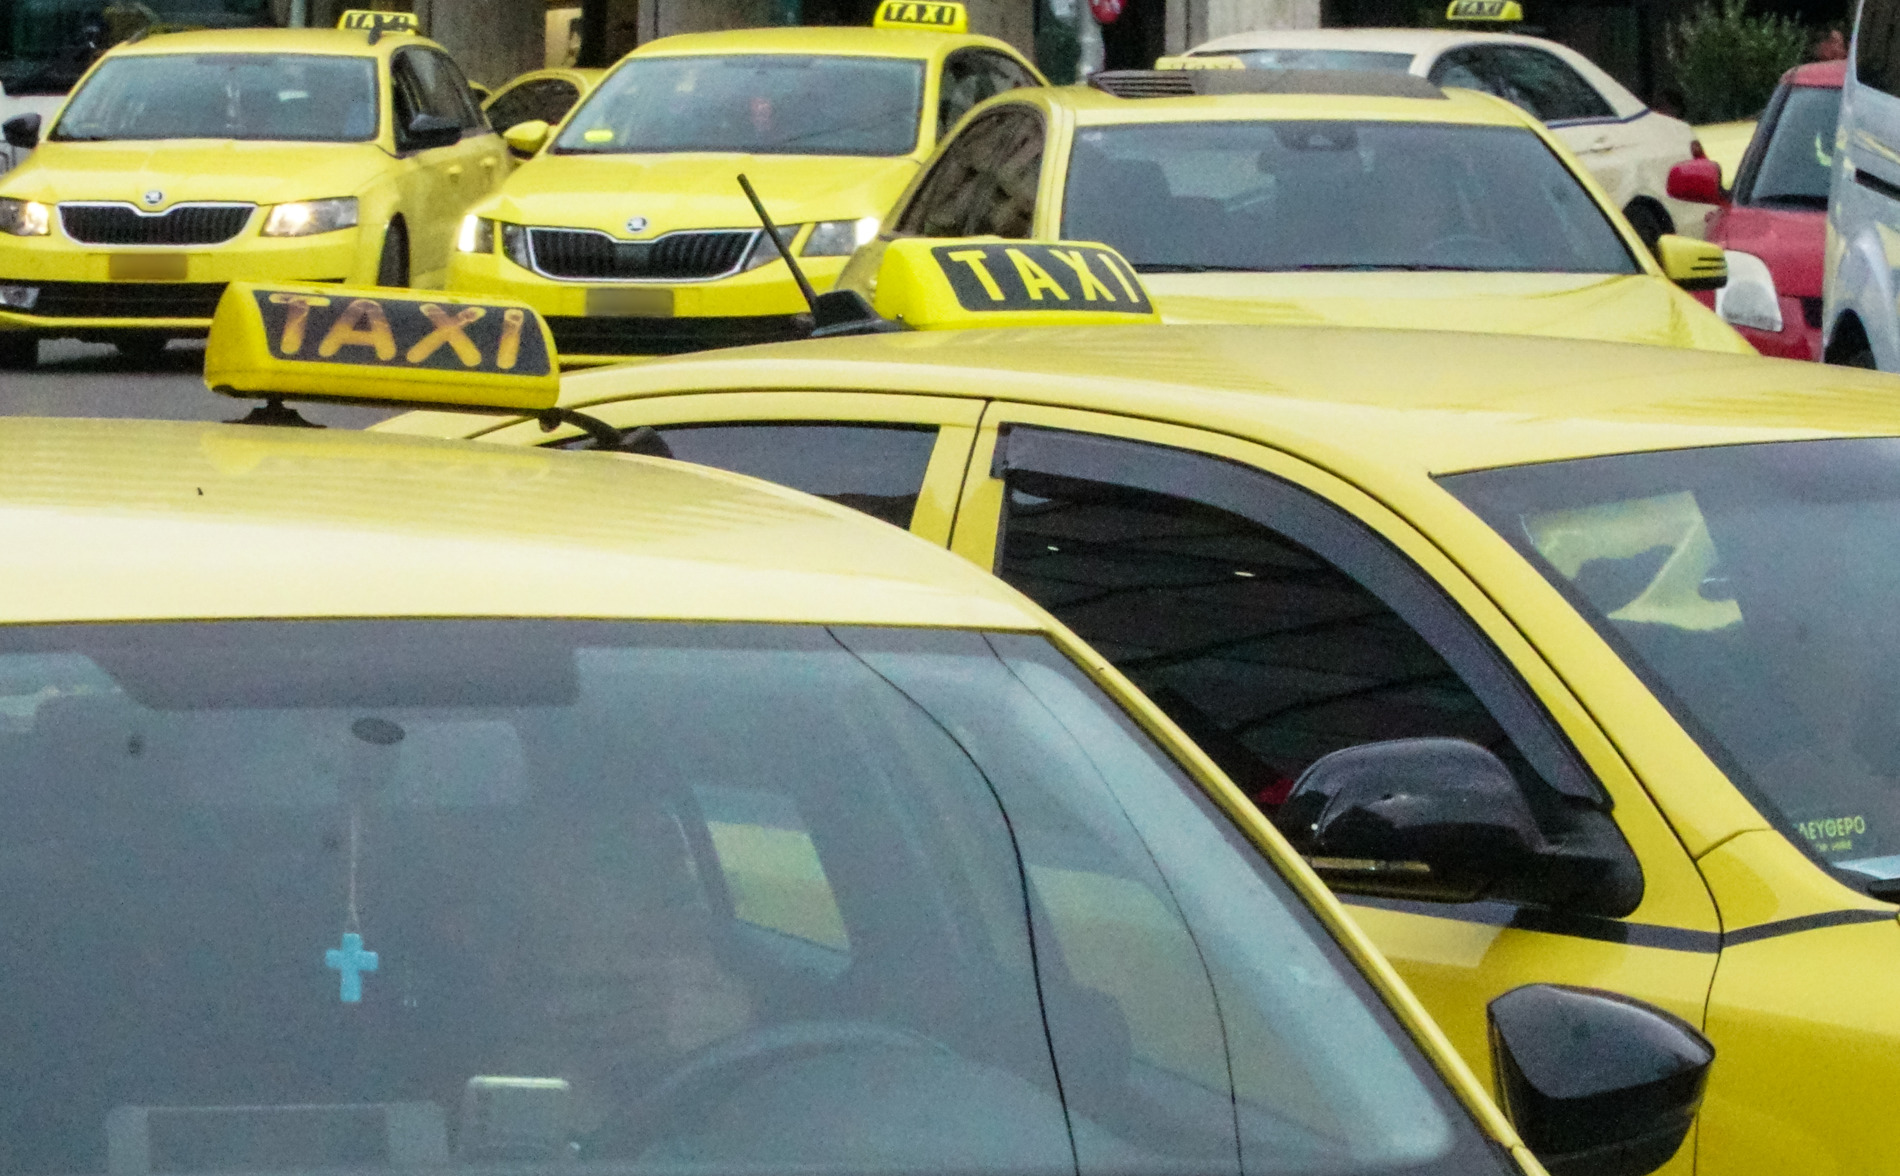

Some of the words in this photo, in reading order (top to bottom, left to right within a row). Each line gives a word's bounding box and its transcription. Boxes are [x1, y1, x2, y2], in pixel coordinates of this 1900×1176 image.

[889, 4, 952, 23] TAXI
[948, 249, 1140, 303] TAXI
[269, 292, 524, 369] TAXI
[1793, 816, 1866, 839] ΛΕΥΘΕΡΟ
